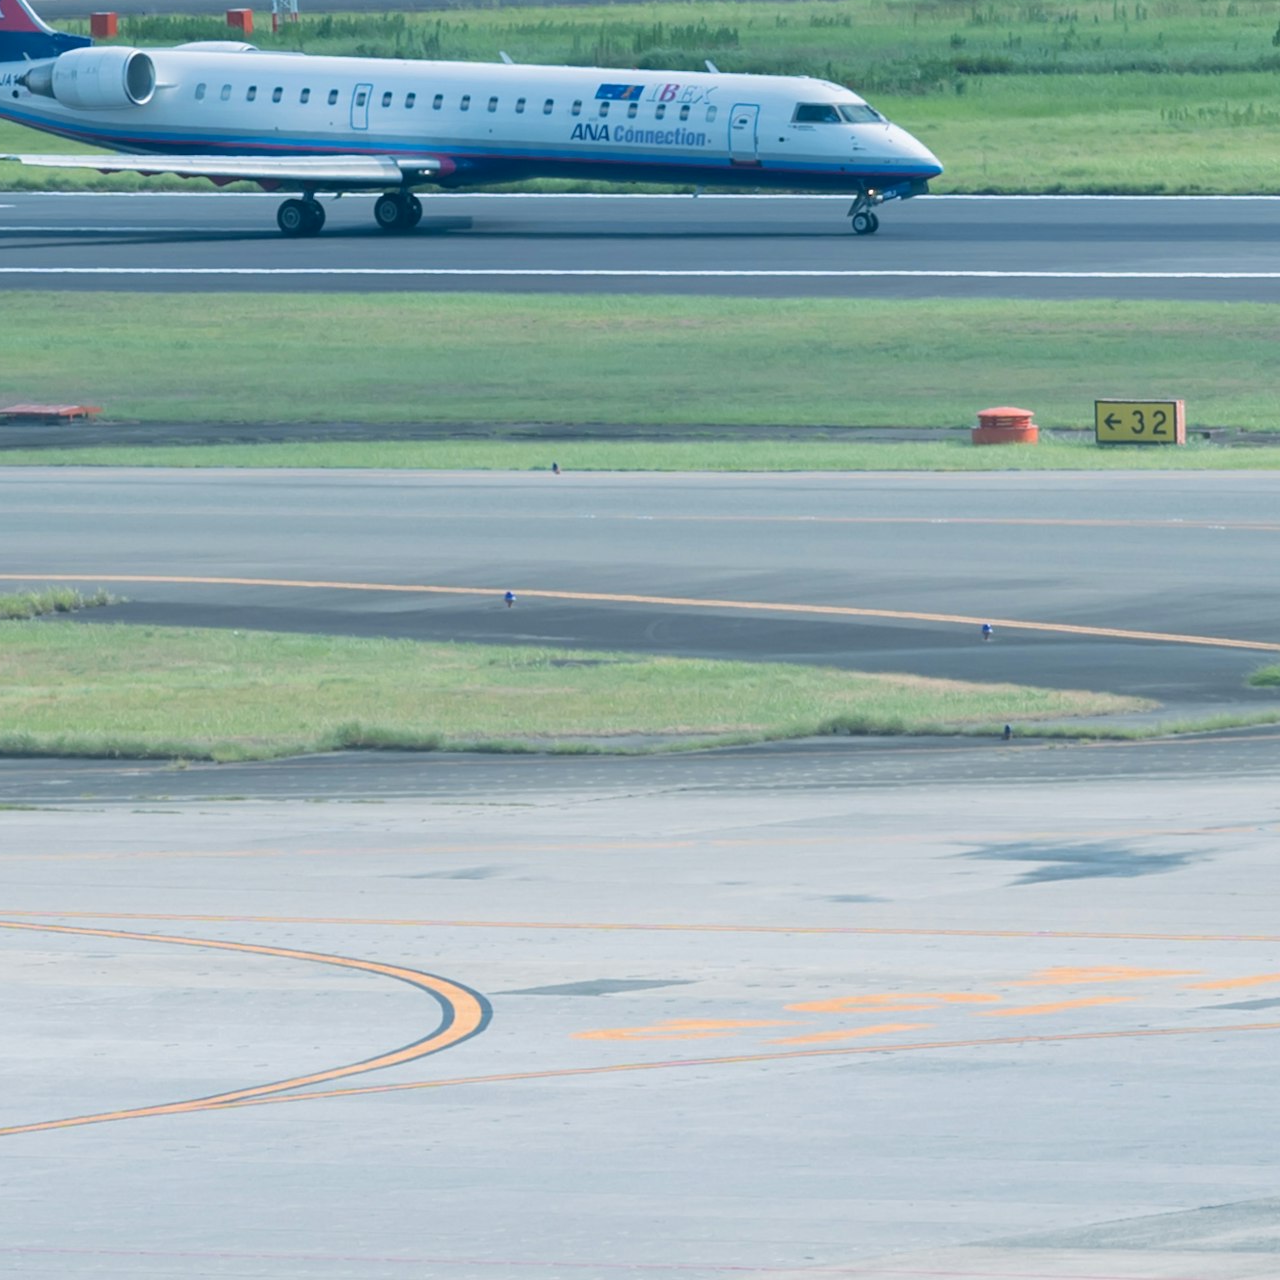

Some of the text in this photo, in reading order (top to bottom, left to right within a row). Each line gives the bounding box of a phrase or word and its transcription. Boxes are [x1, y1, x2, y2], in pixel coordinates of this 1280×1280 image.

[646, 83, 718, 105] IBEX
[570, 123, 706, 147] ANA Connection
[1131, 410, 1168, 435] 32
